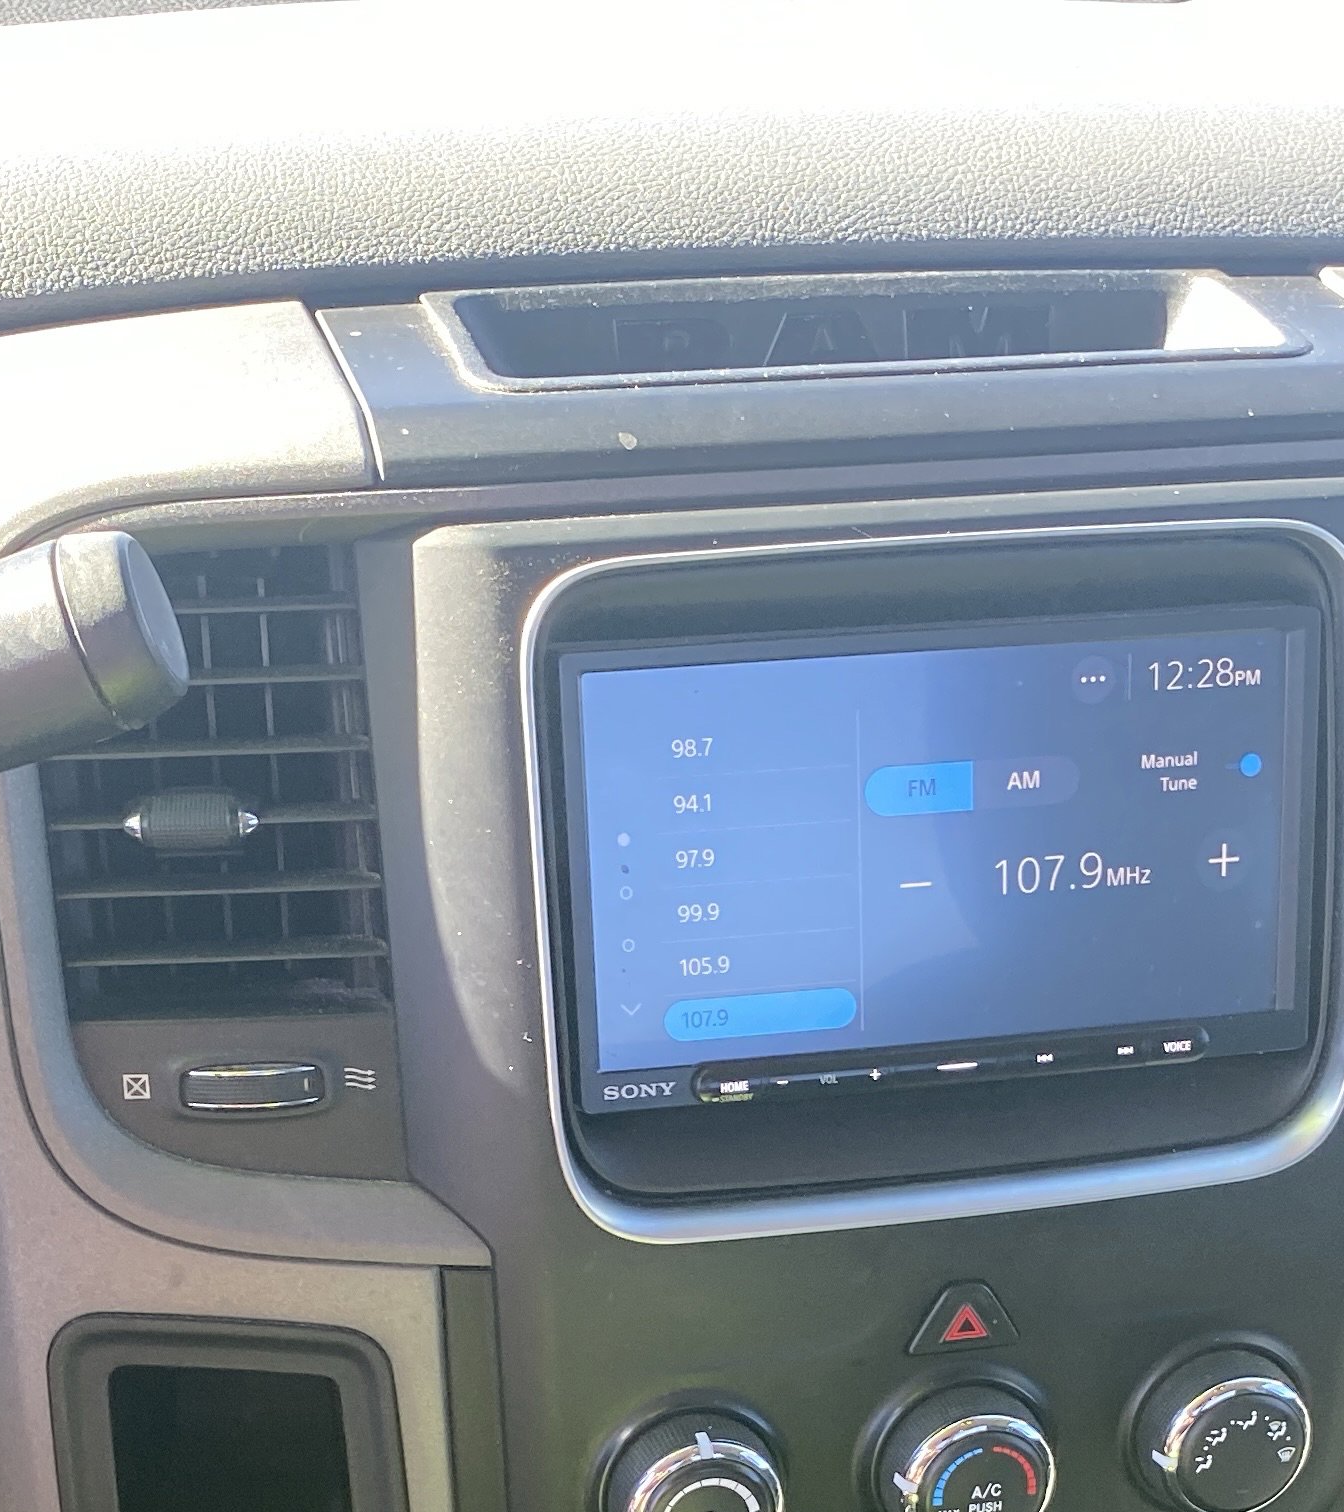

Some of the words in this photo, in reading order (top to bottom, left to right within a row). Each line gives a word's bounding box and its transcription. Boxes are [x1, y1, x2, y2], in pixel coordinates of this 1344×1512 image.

[671, 737, 714, 759] 98.7
[1140, 750, 1199, 770] Manual
[907, 778, 937, 798] FM
[1006, 769, 1042, 791] AM
[1160, 776, 1198, 792] Tune
[673, 793, 712, 814] 94.1
[675, 848, 716, 870] 97.9
[677, 902, 721, 924] 99.9
[679, 955, 731, 977] 105.9
[681, 1008, 730, 1029] 107.9
[1162, 1039, 1193, 1054] VOICE
[603, 1081, 677, 1101] SONY
[719, 1080, 750, 1094] HOME
[971, 1482, 1002, 1500] A/C
